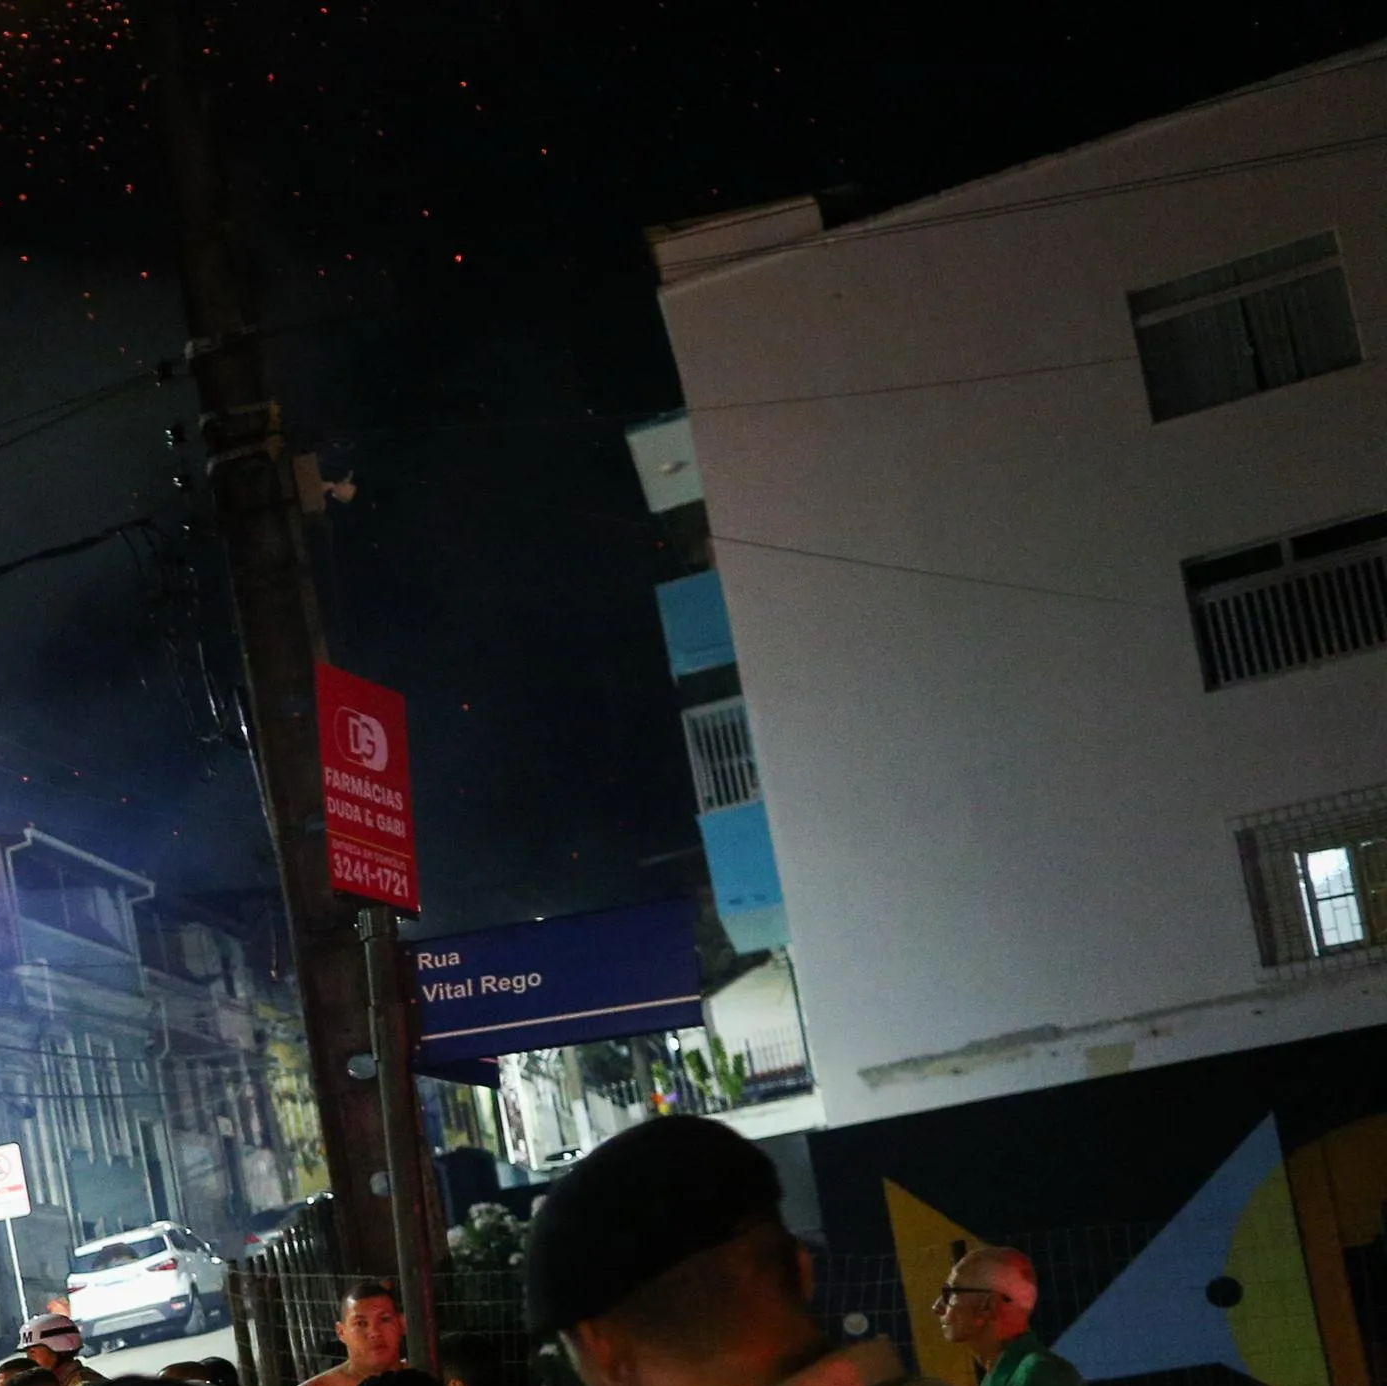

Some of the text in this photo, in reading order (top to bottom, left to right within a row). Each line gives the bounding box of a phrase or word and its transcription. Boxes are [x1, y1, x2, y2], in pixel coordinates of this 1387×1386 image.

[324, 766, 404, 812] FARMÁCIAS
[327, 796, 407, 839] DUDA & GABI
[333, 852, 409, 899] 3241-1721
[417, 952, 460, 971] Rua
[422, 972, 543, 1003] Vital Rego
